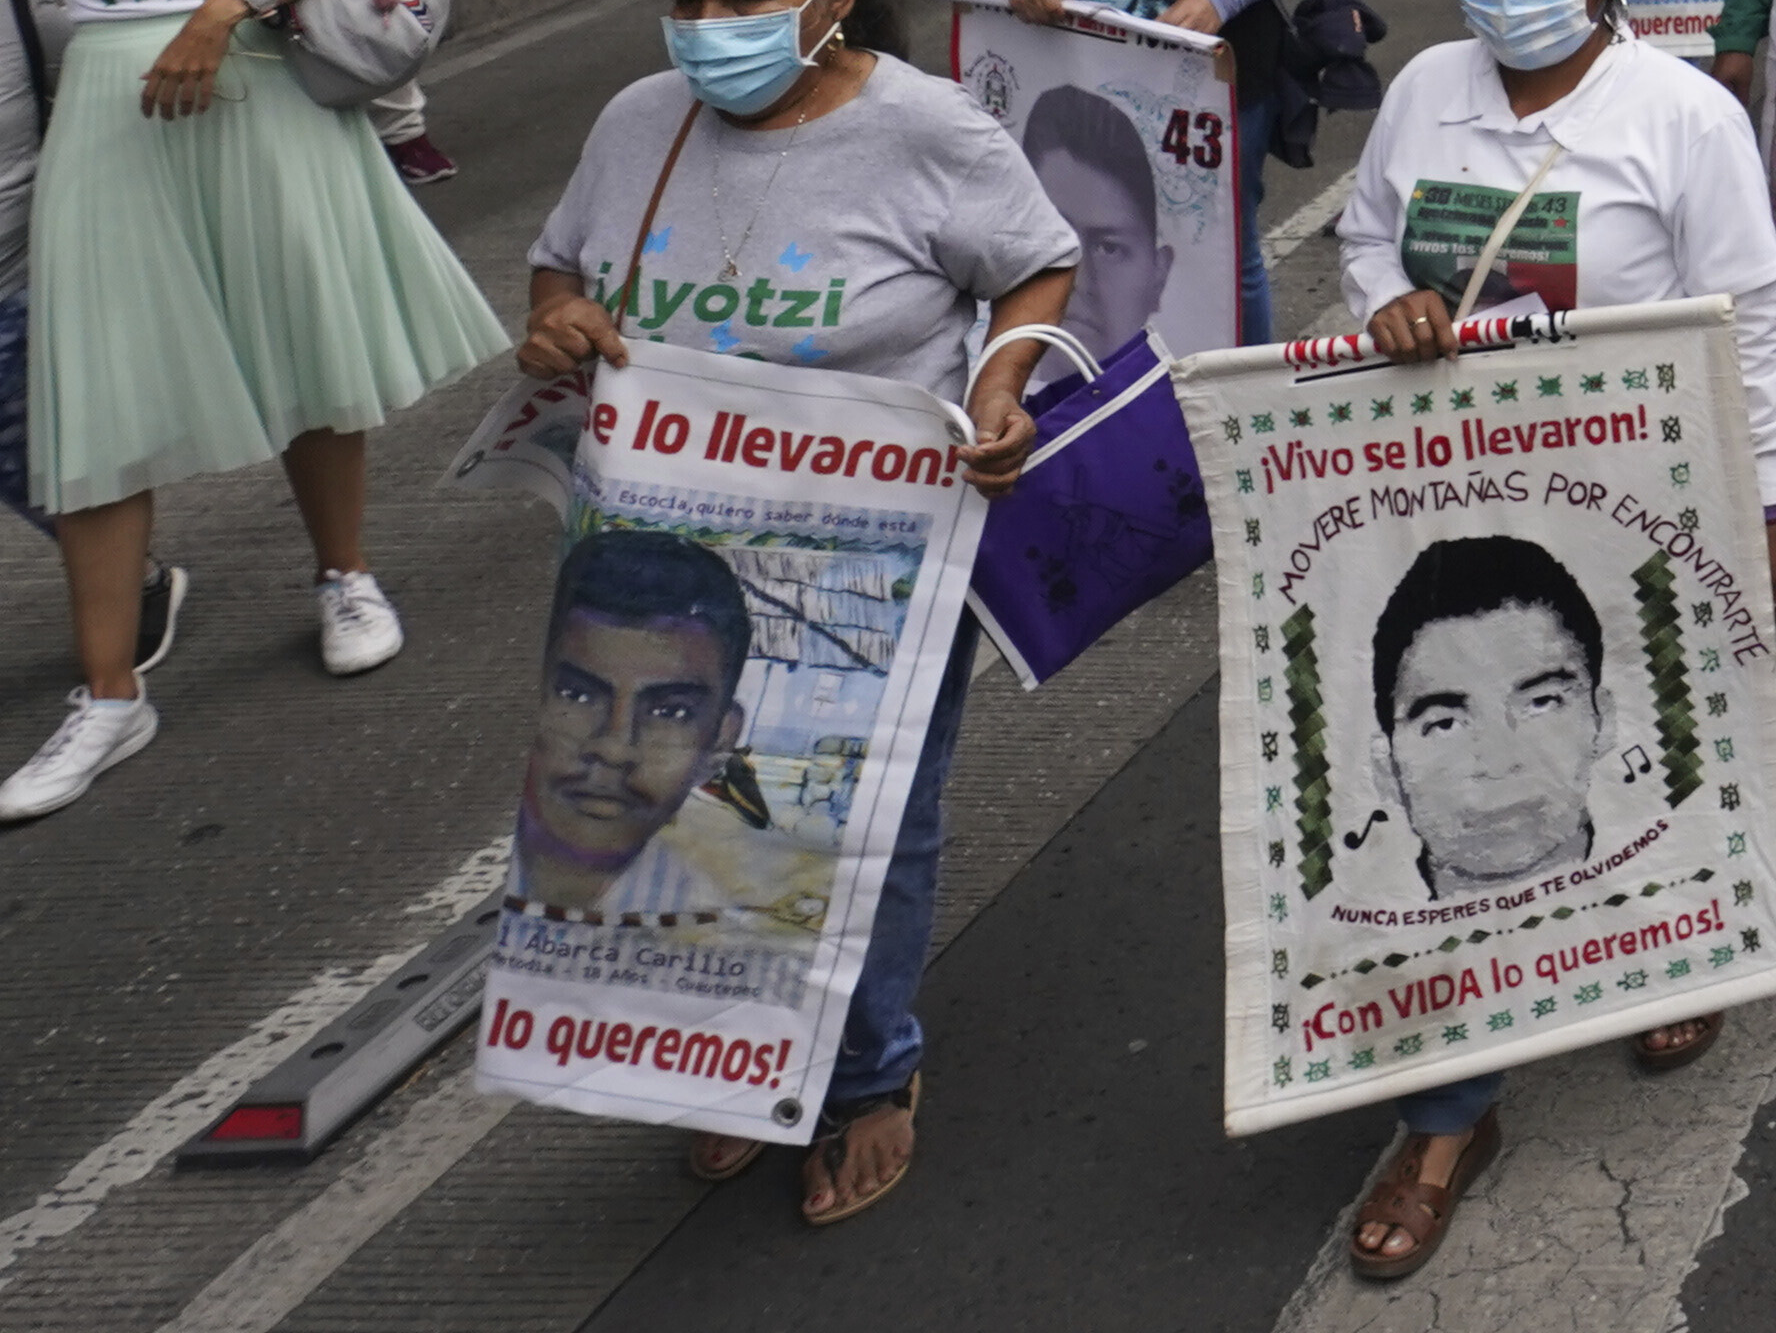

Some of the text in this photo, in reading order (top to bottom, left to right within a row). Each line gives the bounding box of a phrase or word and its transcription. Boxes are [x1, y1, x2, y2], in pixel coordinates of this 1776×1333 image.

[1161, 109, 1223, 169] 43
[1541, 195, 1568, 216] 43
[632, 399, 691, 456] lo
[703, 411, 960, 489] llevaron!
[1261, 403, 1650, 494] ¡Vivo se lo llevaron!
[1280, 469, 1771, 667] MOVERE MONTAÑAS POR ENCONTRARTE
[1331, 819, 1671, 931] NUNCA ESPERES QUE TE OLVIDEMOS
[525, 932, 619, 963] Abarca
[635, 946, 746, 977] Carillo
[1302, 899, 1728, 1052] ¡Con VIDA lo queremos!
[486, 998, 793, 1090] lo queremos!
